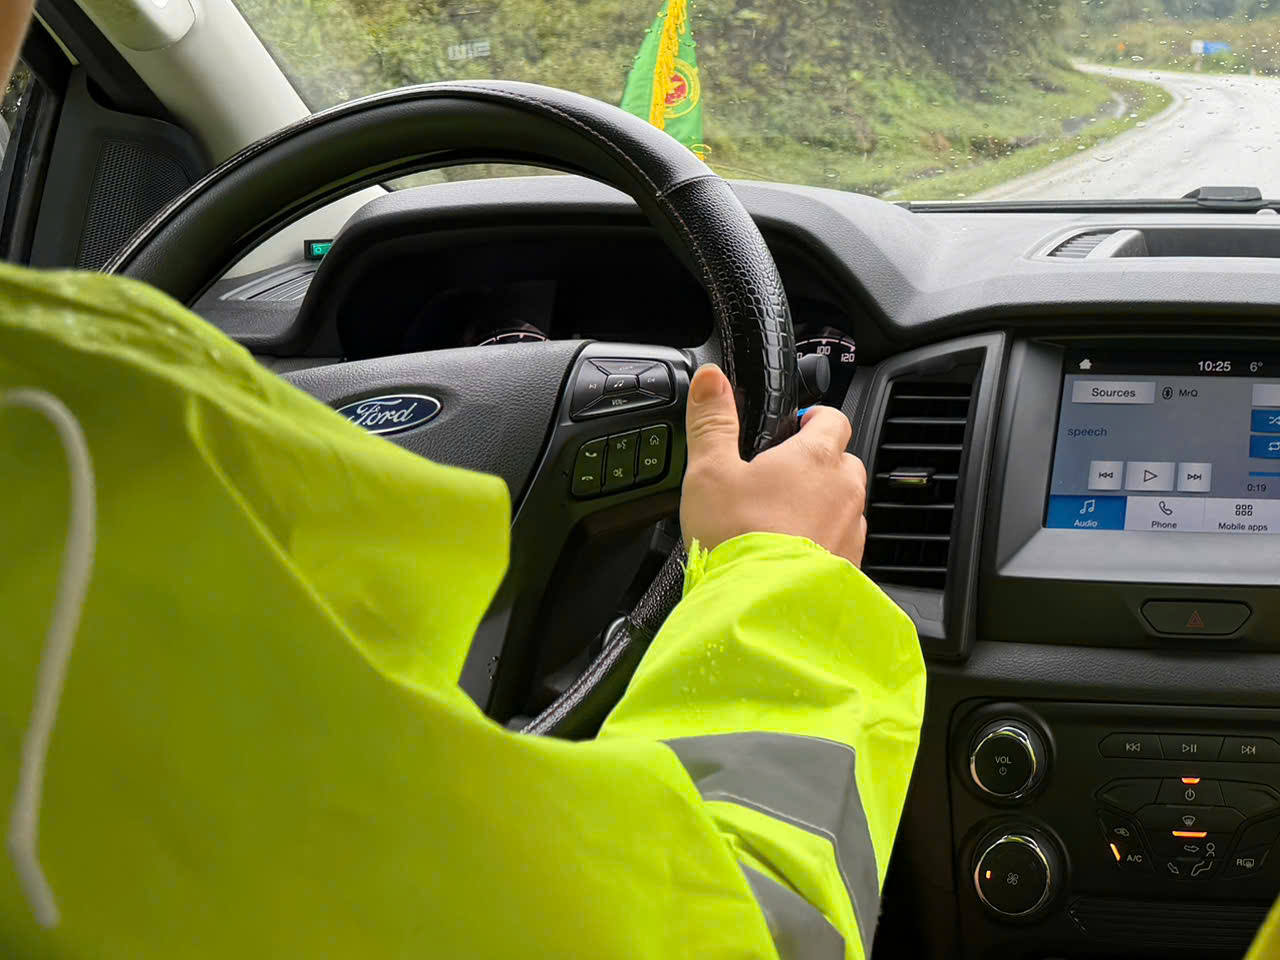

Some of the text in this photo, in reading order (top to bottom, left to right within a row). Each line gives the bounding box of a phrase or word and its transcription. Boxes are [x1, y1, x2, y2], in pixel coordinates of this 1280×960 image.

[816, 346, 831, 355] 100
[840, 353, 855, 362] 120
[1198, 360, 1231, 372] 10:25
[1091, 387, 1136, 398] Sources
[347, 398, 418, 426] Ford
[1067, 425, 1108, 438] speech
[1247, 483, 1267, 493] 0:19
[1073, 518, 1098, 528] Audio
[1151, 520, 1177, 529] Phone
[1218, 522, 1268, 533] Mobile apps
[994, 755, 1012, 765] VOL
[1126, 854, 1143, 864] A/C
